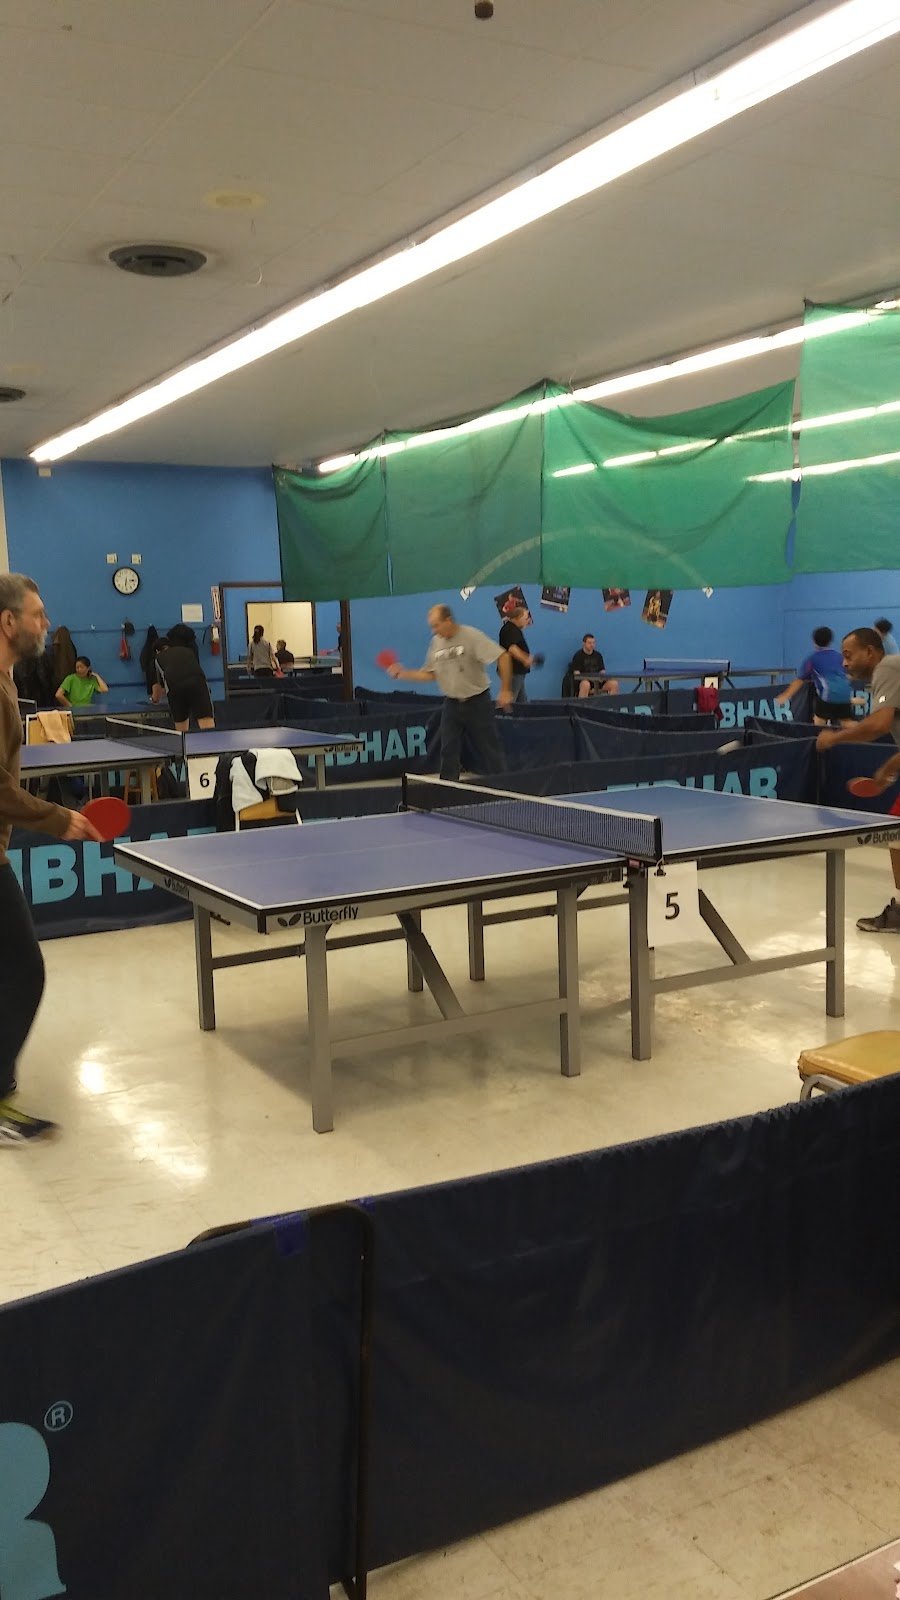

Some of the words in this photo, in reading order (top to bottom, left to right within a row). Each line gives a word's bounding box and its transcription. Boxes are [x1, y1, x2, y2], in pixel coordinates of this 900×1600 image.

[199, 772, 210, 788] 6
[303, 906, 359, 926] Butterfly
[665, 892, 680, 920] 5
